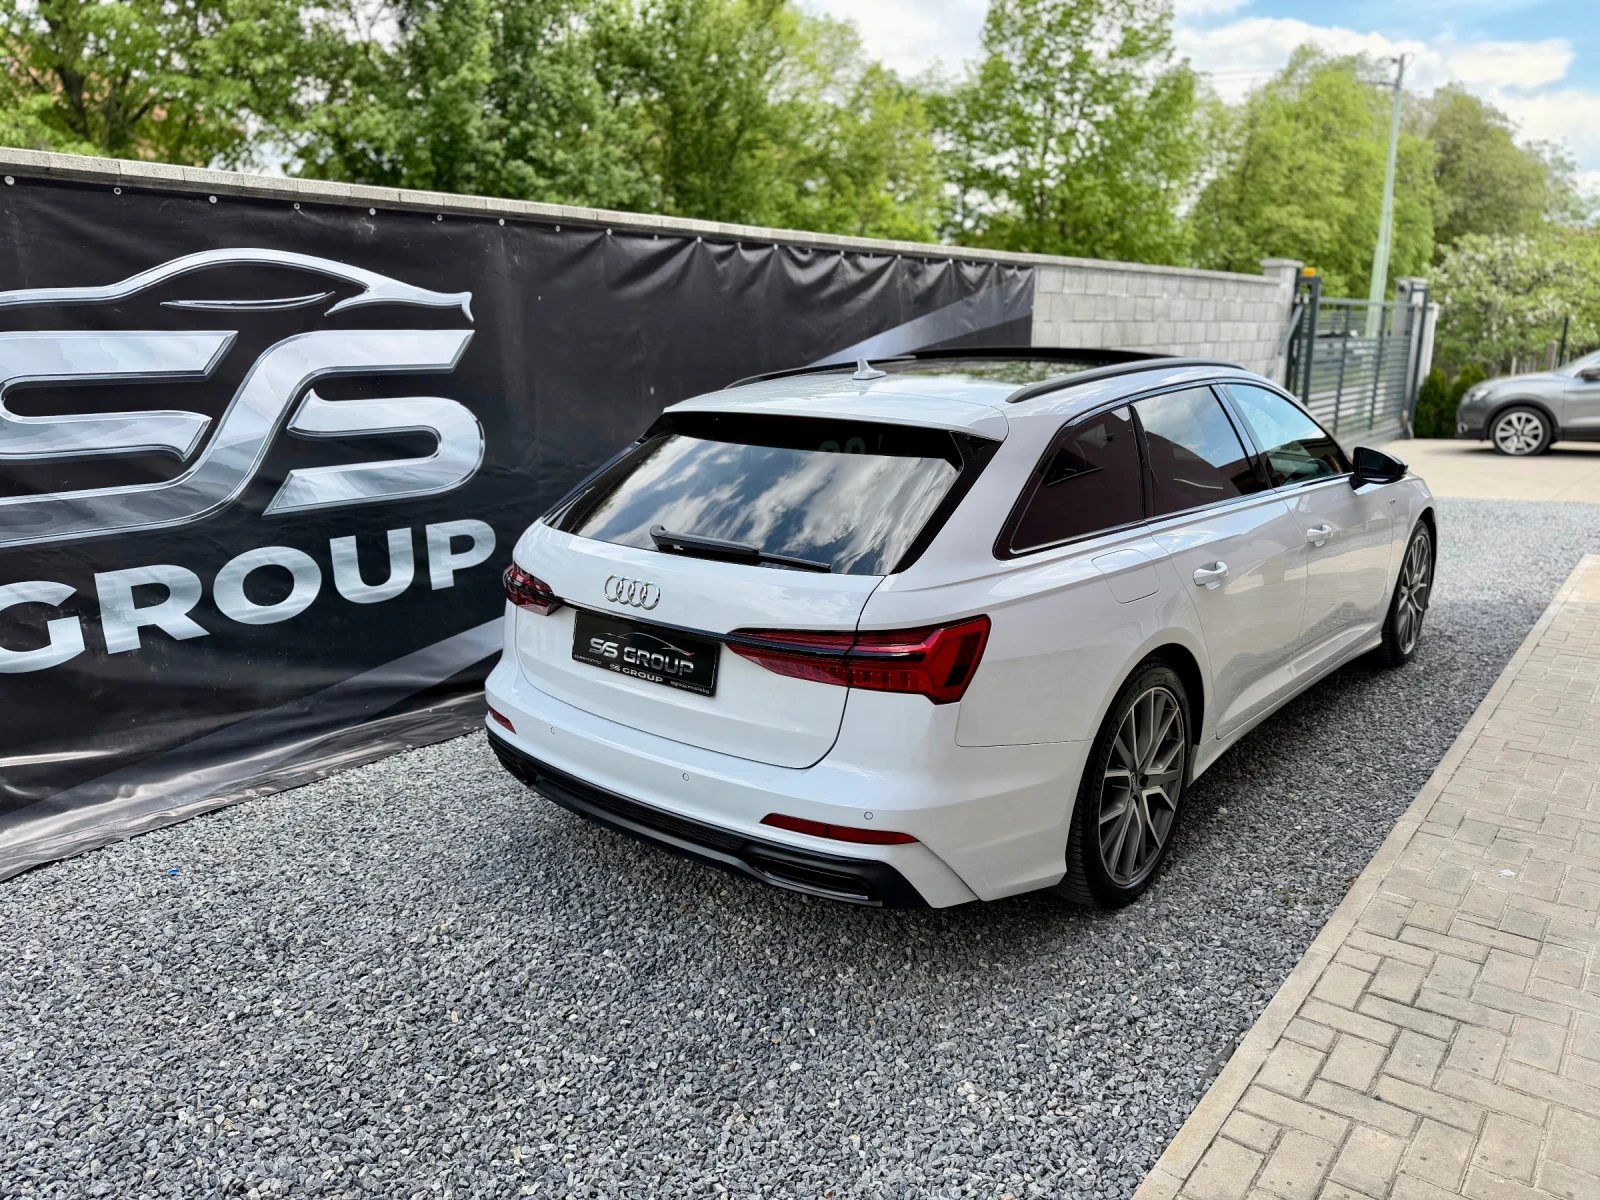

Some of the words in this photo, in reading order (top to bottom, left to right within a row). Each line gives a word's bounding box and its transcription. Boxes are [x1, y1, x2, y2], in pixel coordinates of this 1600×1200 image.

[0, 519, 497, 673] GROUP
[622, 666, 664, 683] GROUP
[623, 646, 695, 676] GROUP
